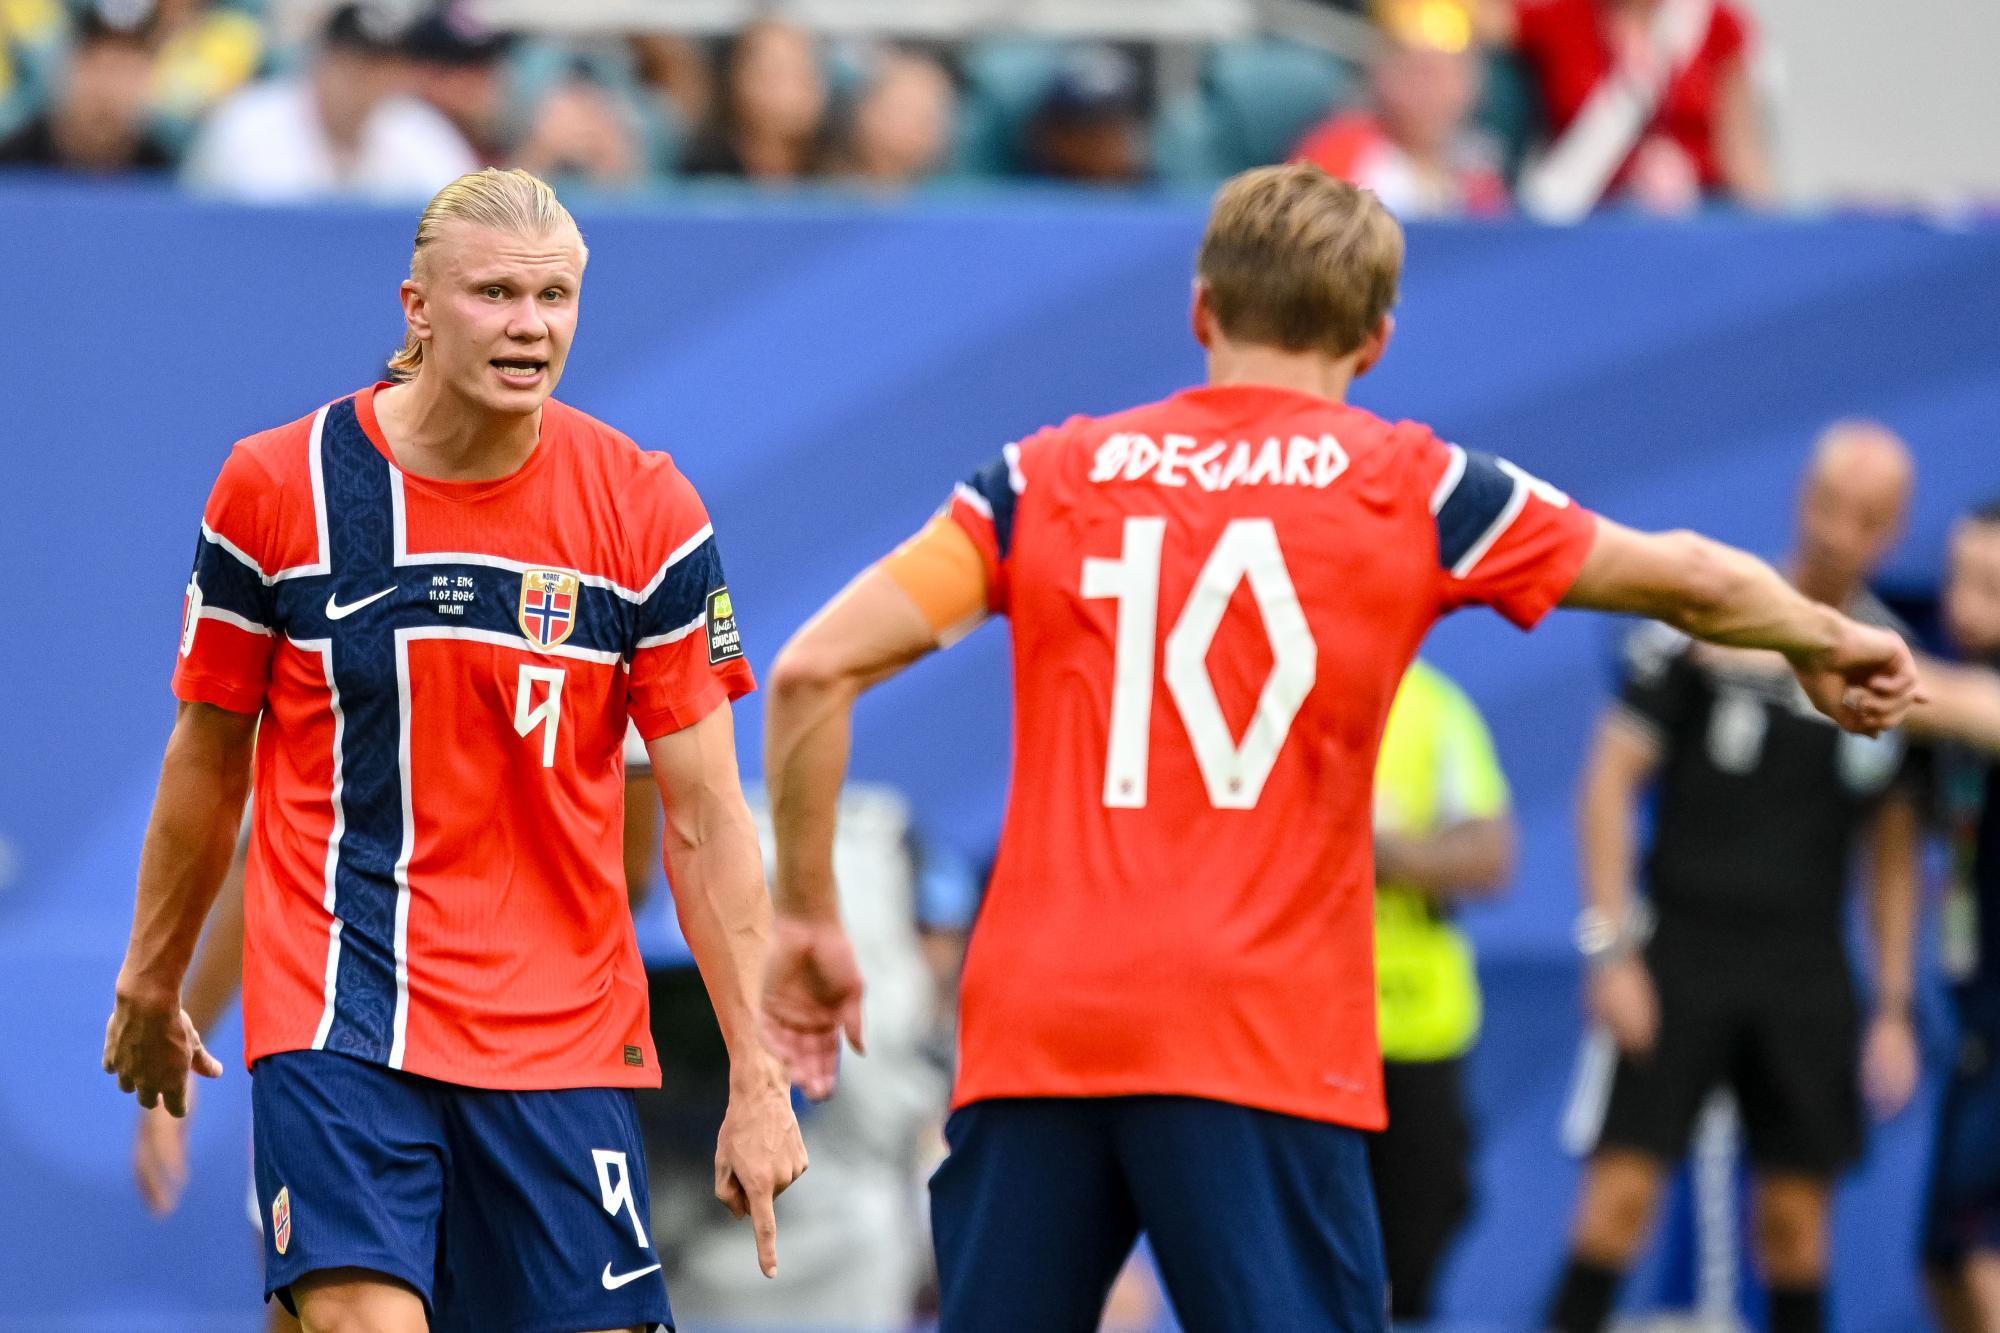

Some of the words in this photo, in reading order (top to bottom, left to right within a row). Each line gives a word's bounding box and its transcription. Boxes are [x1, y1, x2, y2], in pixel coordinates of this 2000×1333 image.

[1089, 432, 1350, 491] ØDEGAARD
[432, 576, 448, 586] NOR
[457, 576, 473, 587] ENG
[438, 604, 463, 615] MIAMI
[712, 631, 740, 649] EDUCATI
[722, 644, 739, 654] FIFA
[1079, 516, 1318, 810] 10
[514, 664, 566, 768] 9
[592, 1149, 649, 1248] 9
